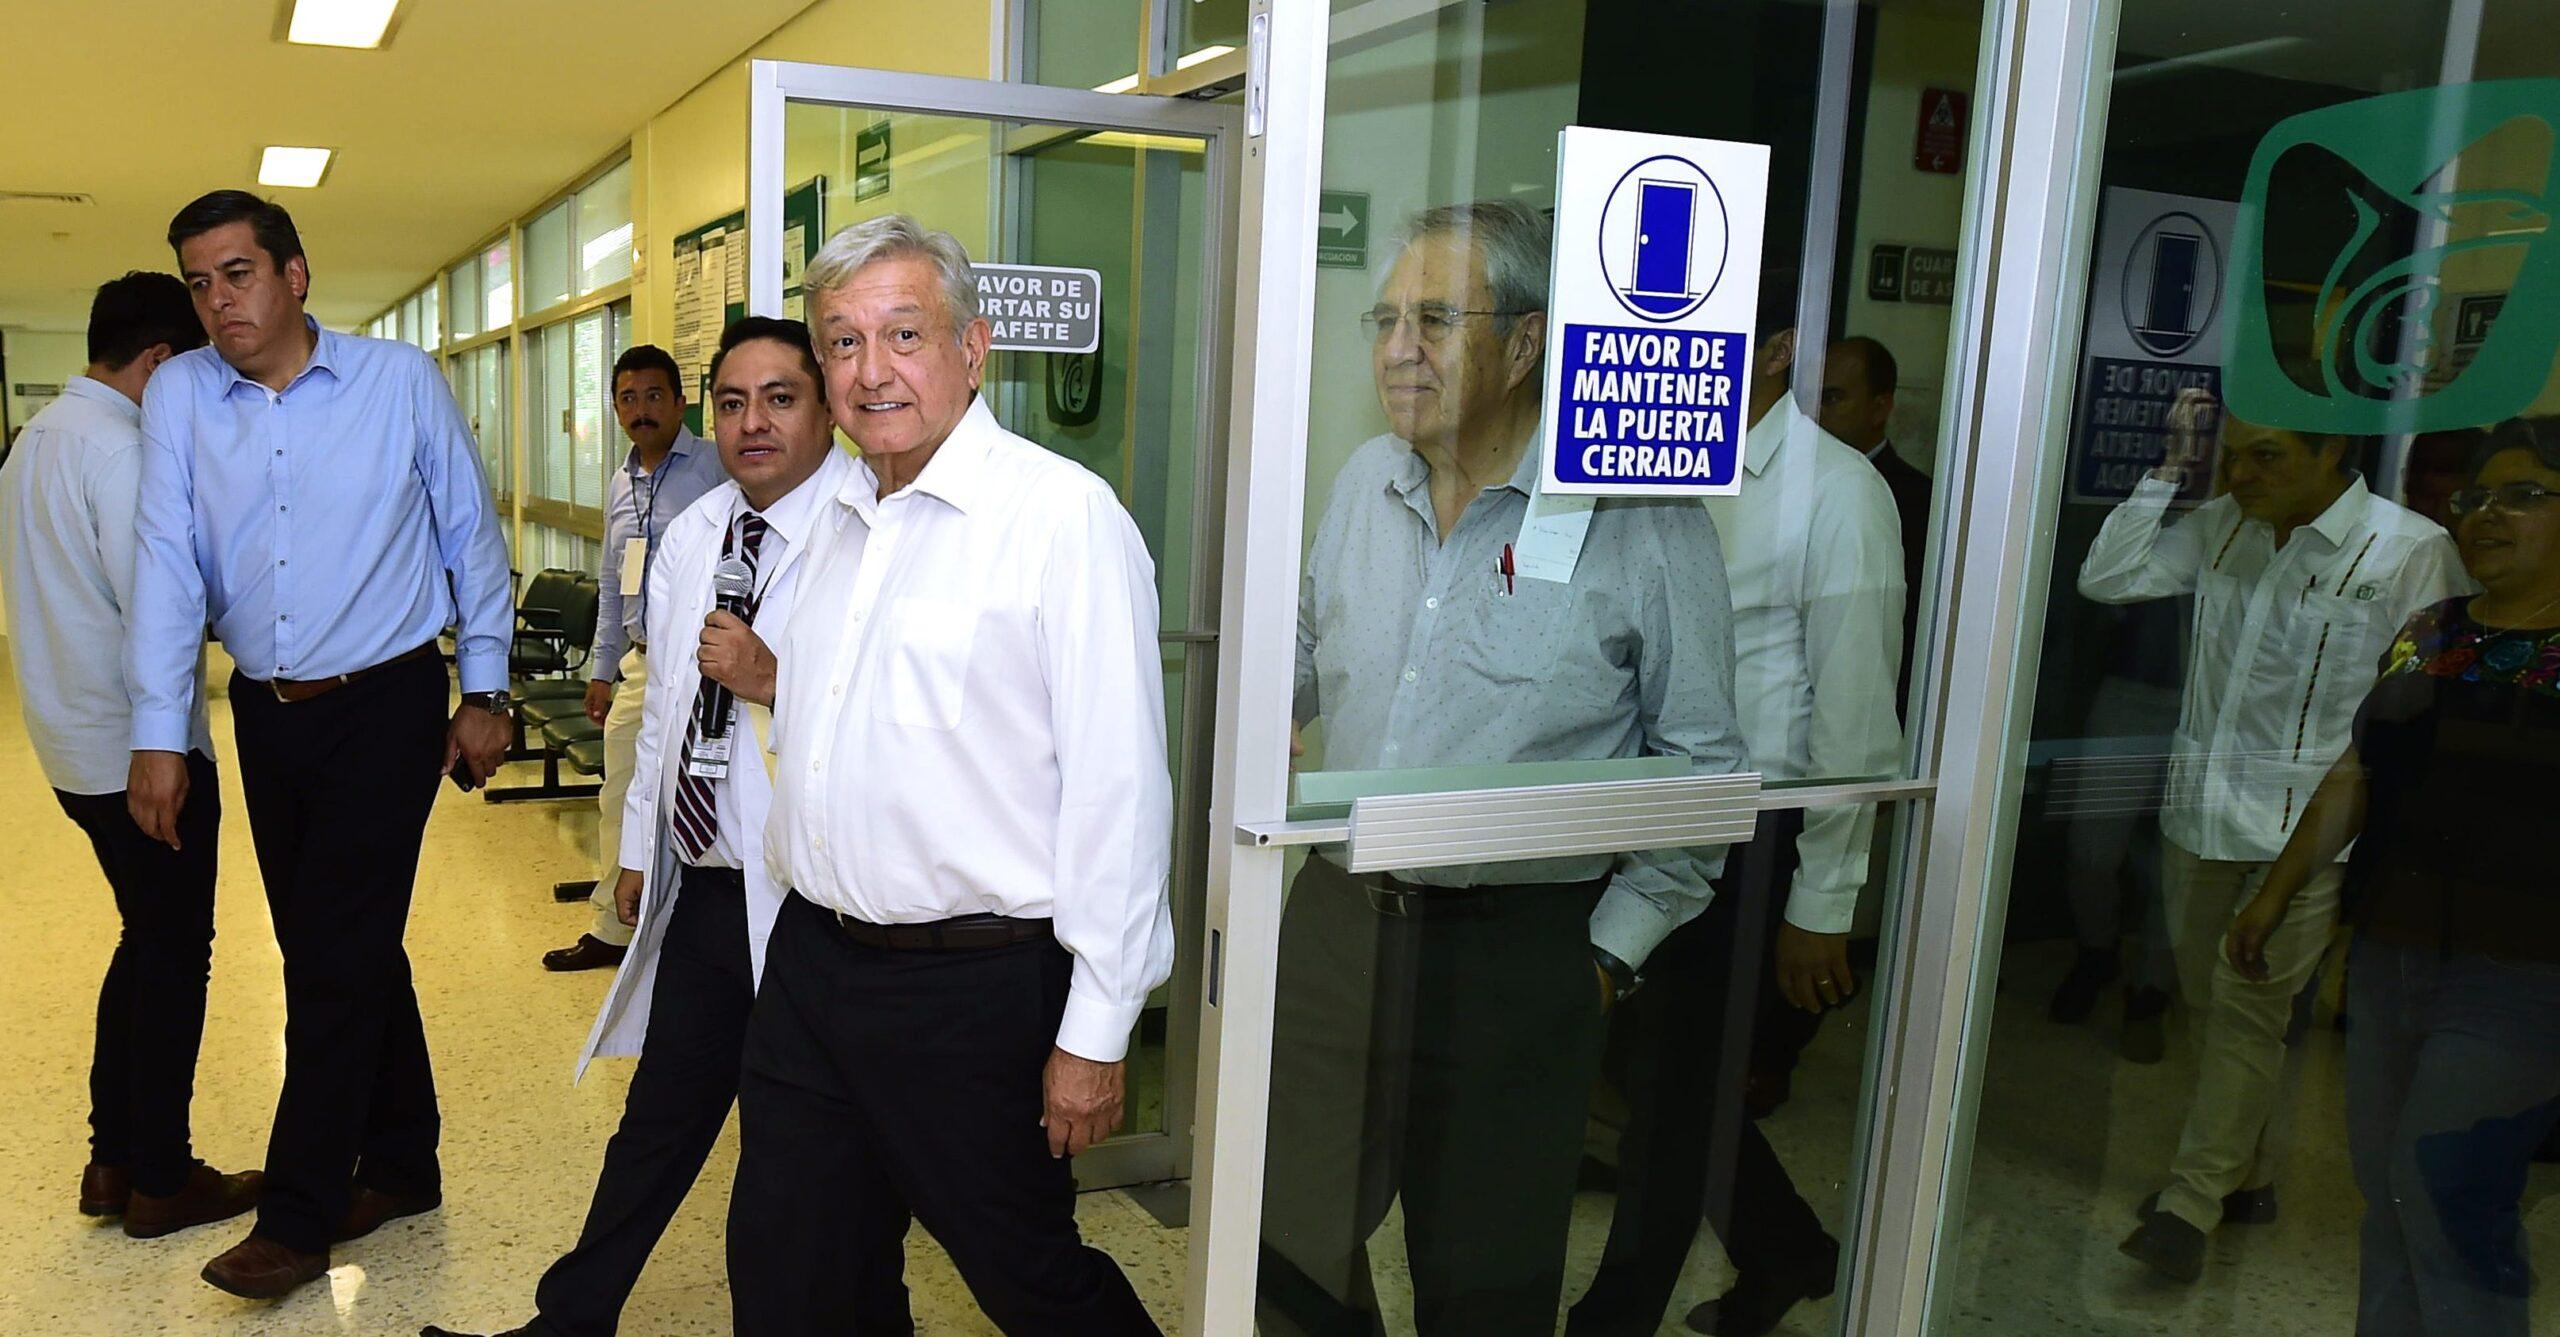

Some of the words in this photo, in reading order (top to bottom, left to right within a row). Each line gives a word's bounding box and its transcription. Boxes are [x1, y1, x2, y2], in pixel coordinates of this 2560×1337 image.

[1913, 256, 1955, 273] CUAR
[975, 275, 1042, 296] AVOR
[1051, 279, 1082, 298] DE
[1911, 280, 1931, 296] DE
[978, 298, 1051, 318] RTAR
[1059, 301, 1091, 320] SU
[992, 320, 1069, 341] AFETE
[1585, 332, 1681, 367] FAVOR
[1689, 337, 1726, 369] DE
[1574, 407, 1608, 439] LA
[1617, 408, 1724, 442] PUERTA
[1581, 444, 1711, 478] CERRADA
